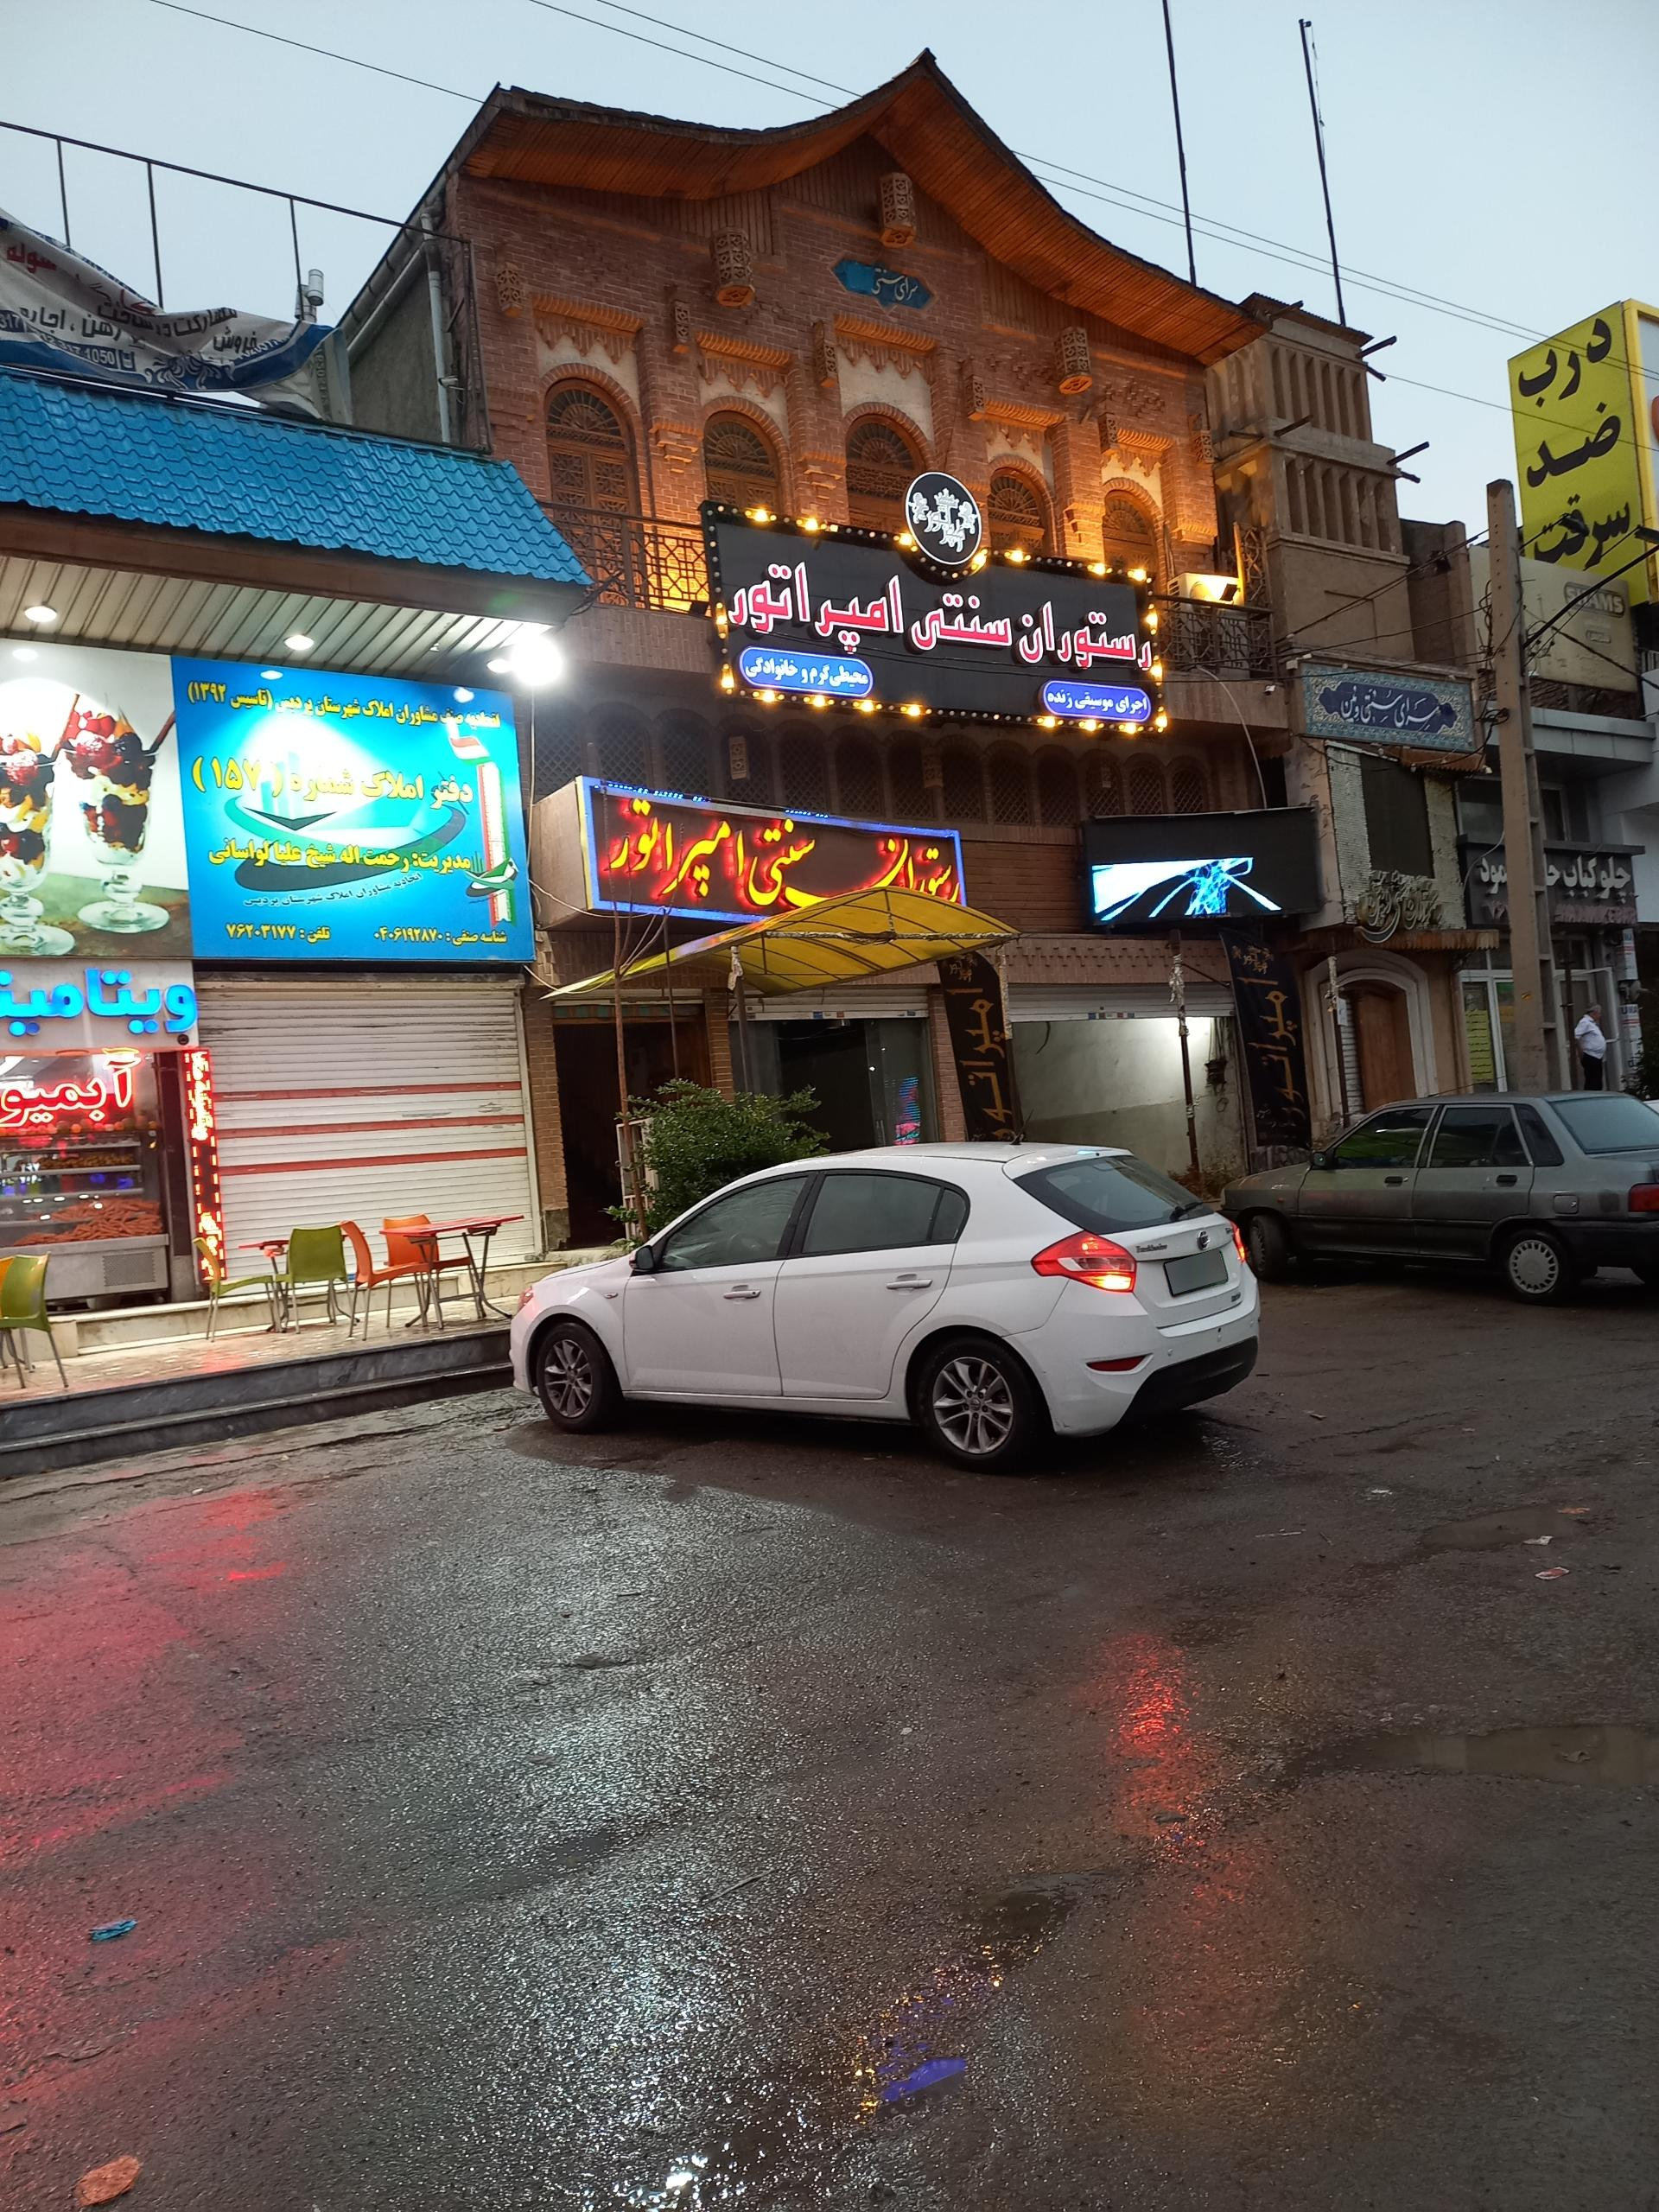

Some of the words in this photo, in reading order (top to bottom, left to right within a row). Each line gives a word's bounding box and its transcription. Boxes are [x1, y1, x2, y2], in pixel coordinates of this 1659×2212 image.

[7, 243, 57, 274] سوله
[872, 267, 905, 295] سنتی
[894, 276, 918, 301] سرای
[1518, 318, 1611, 408] درب
[1527, 402, 1621, 487] ضد
[1534, 493, 1630, 571] سرقت
[728, 561, 905, 655] امپراتور
[911, 593, 1013, 651] سنتی
[1020, 600, 1154, 671] رستوران
[745, 657, 798, 681] خانوادگی
[800, 667, 809, 683] و
[810, 664, 830, 686] گرم
[829, 664, 869, 688] محیطی
[315, 695, 361, 719] شهرستان
[361, 698, 395, 719] املاک
[1046, 689, 1073, 709] زنده
[1074, 691, 1114, 712] موسیقی
[1115, 695, 1147, 715] اجرای
[395, 703, 439, 727] مشاوران
[360, 770, 425, 800] املاک
[429, 772, 474, 810] دفتر
[208, 836, 270, 868] لواسانی
[305, 843, 337, 870] شیخ
[340, 843, 360, 865] اله
[610, 798, 745, 898] امپراتور
[362, 849, 410, 874] رحمت
[411, 851, 472, 875] مدیریت:
[747, 818, 815, 906] سنتی
[393, 873, 423, 888] اتحادیه
[1561, 855, 1597, 898] کباب
[282, 894, 323, 906] شهرستان
[480, 930, 508, 944] شناسه
[0, 968, 199, 1037] ویتامین
[0, 1049, 142, 1127] آبمیو
